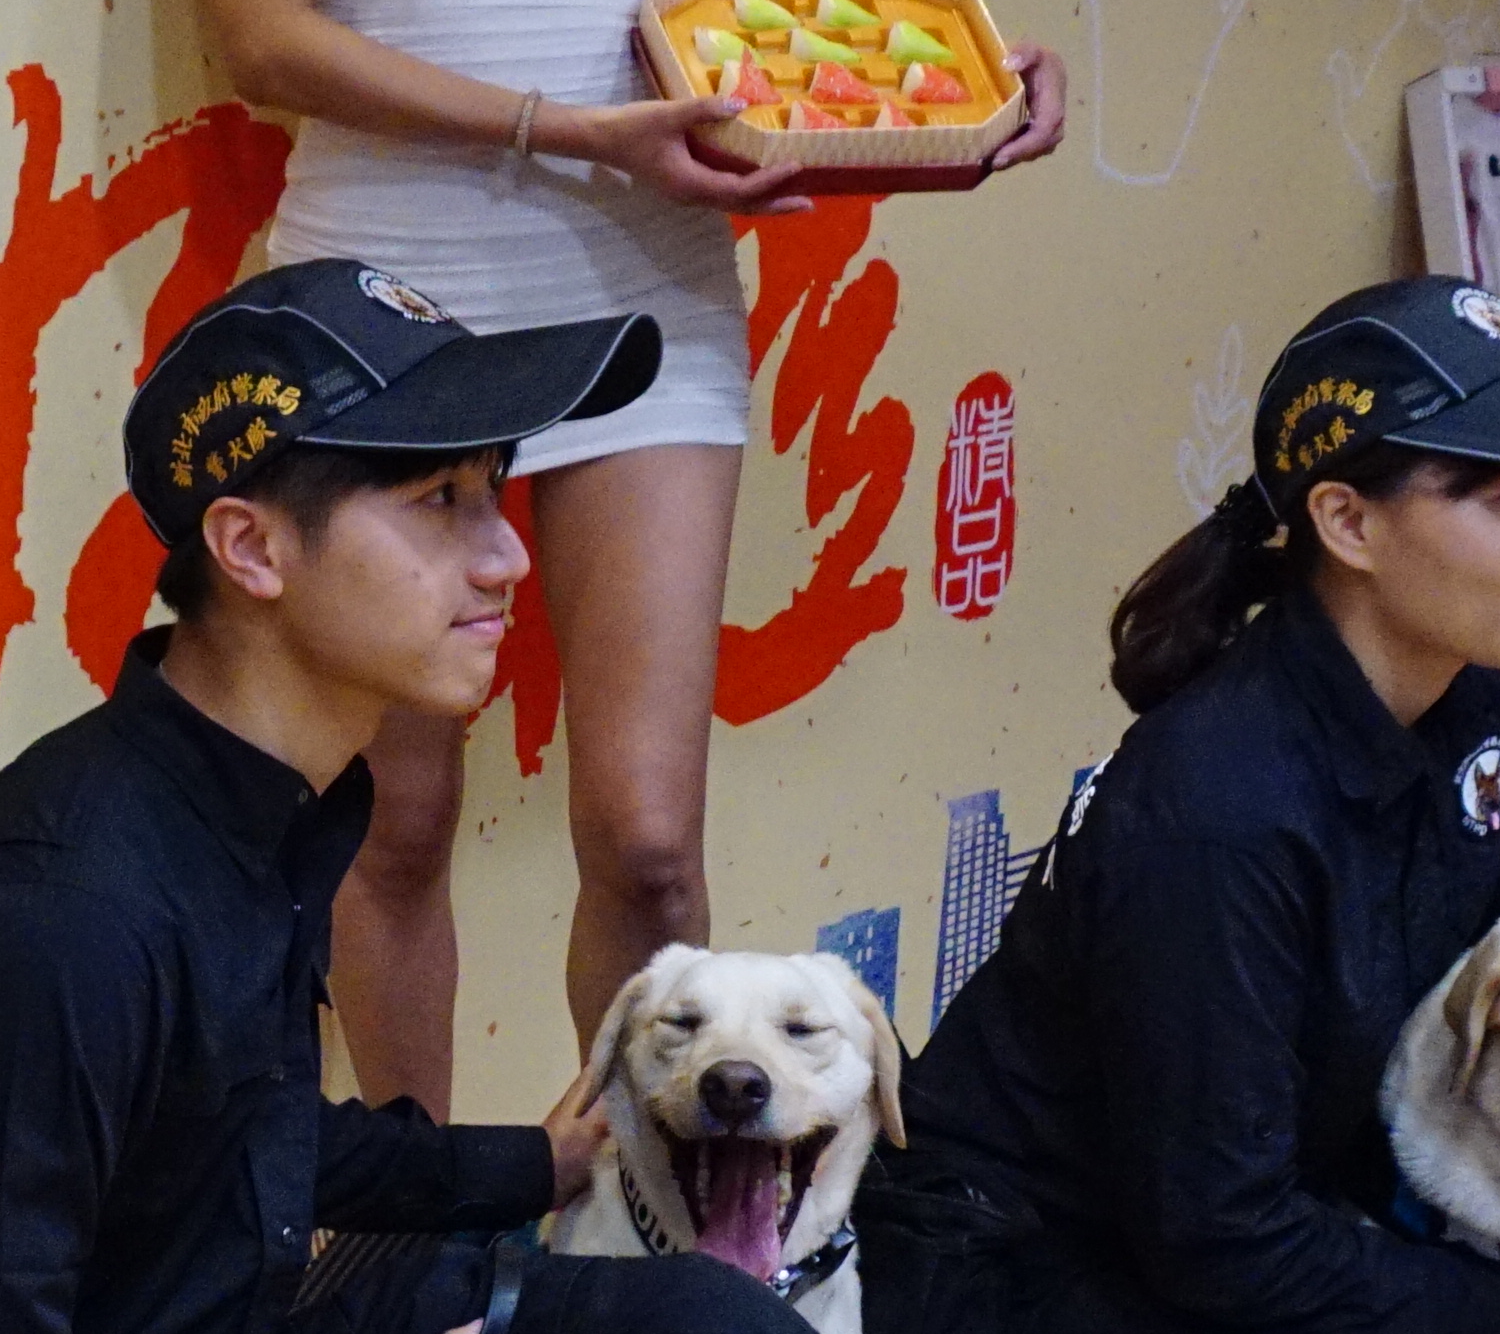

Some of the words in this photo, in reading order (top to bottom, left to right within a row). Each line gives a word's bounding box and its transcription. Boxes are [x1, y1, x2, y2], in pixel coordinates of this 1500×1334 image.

[169, 372, 301, 487] 新北市政府警察局
[206, 415, 277, 483] 警犬隊
[939, 392, 1015, 614] 精品
